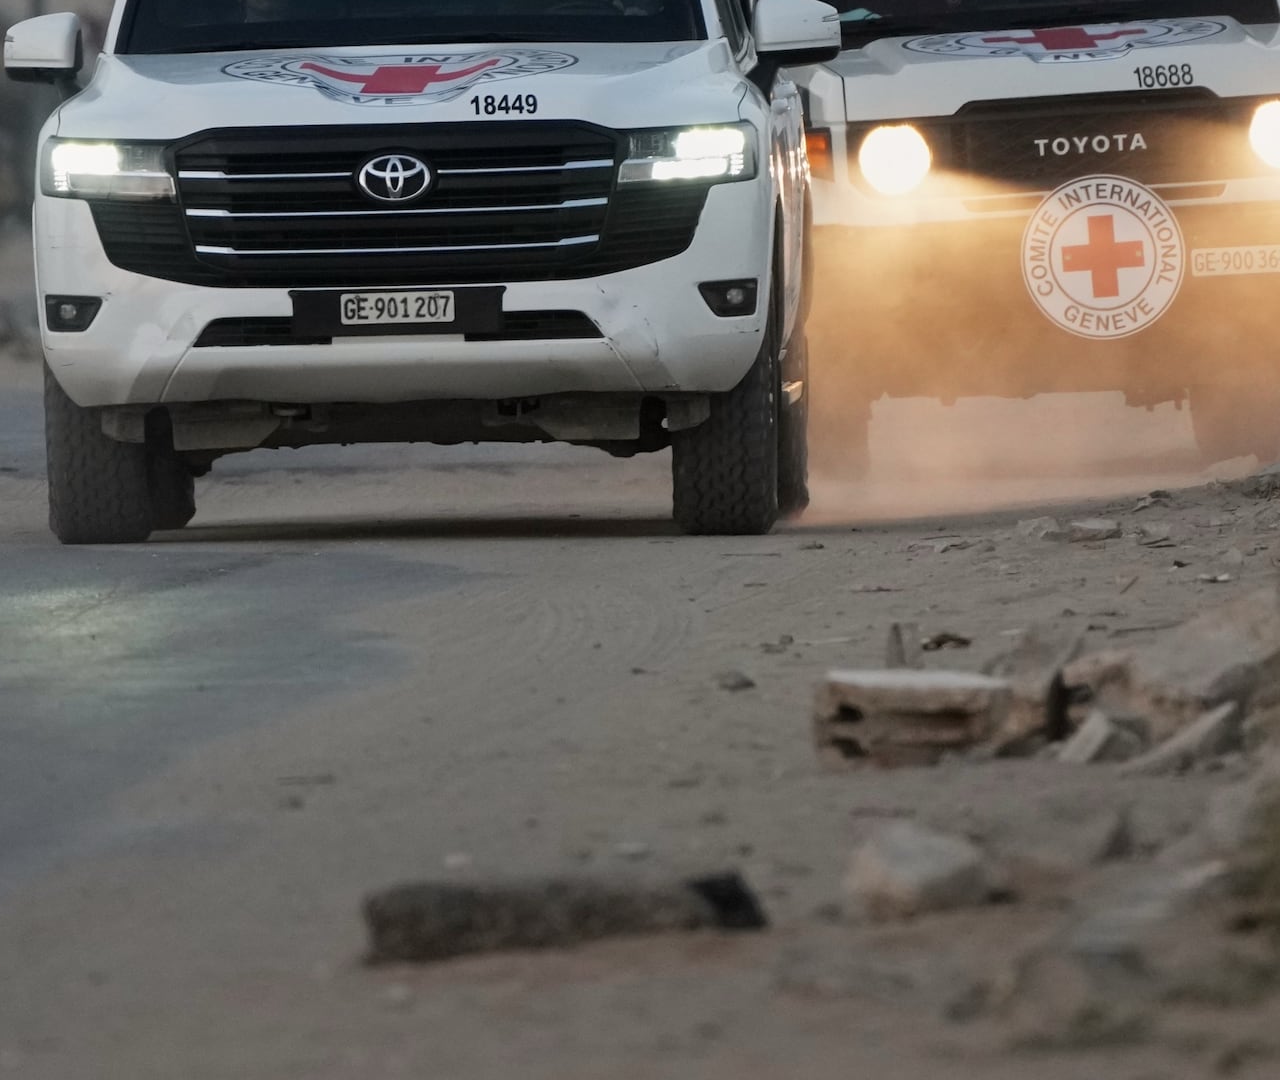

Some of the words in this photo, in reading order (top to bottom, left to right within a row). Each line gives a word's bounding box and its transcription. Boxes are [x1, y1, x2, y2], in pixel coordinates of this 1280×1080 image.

[1133, 63, 1194, 88] 18688
[470, 94, 538, 115] 18449
[1034, 133, 1147, 157] TOYOTA
[1030, 210, 1058, 297] COMITE
[1058, 183, 1178, 285] INTERNATIONAL
[1064, 298, 1155, 332] GENEVE
